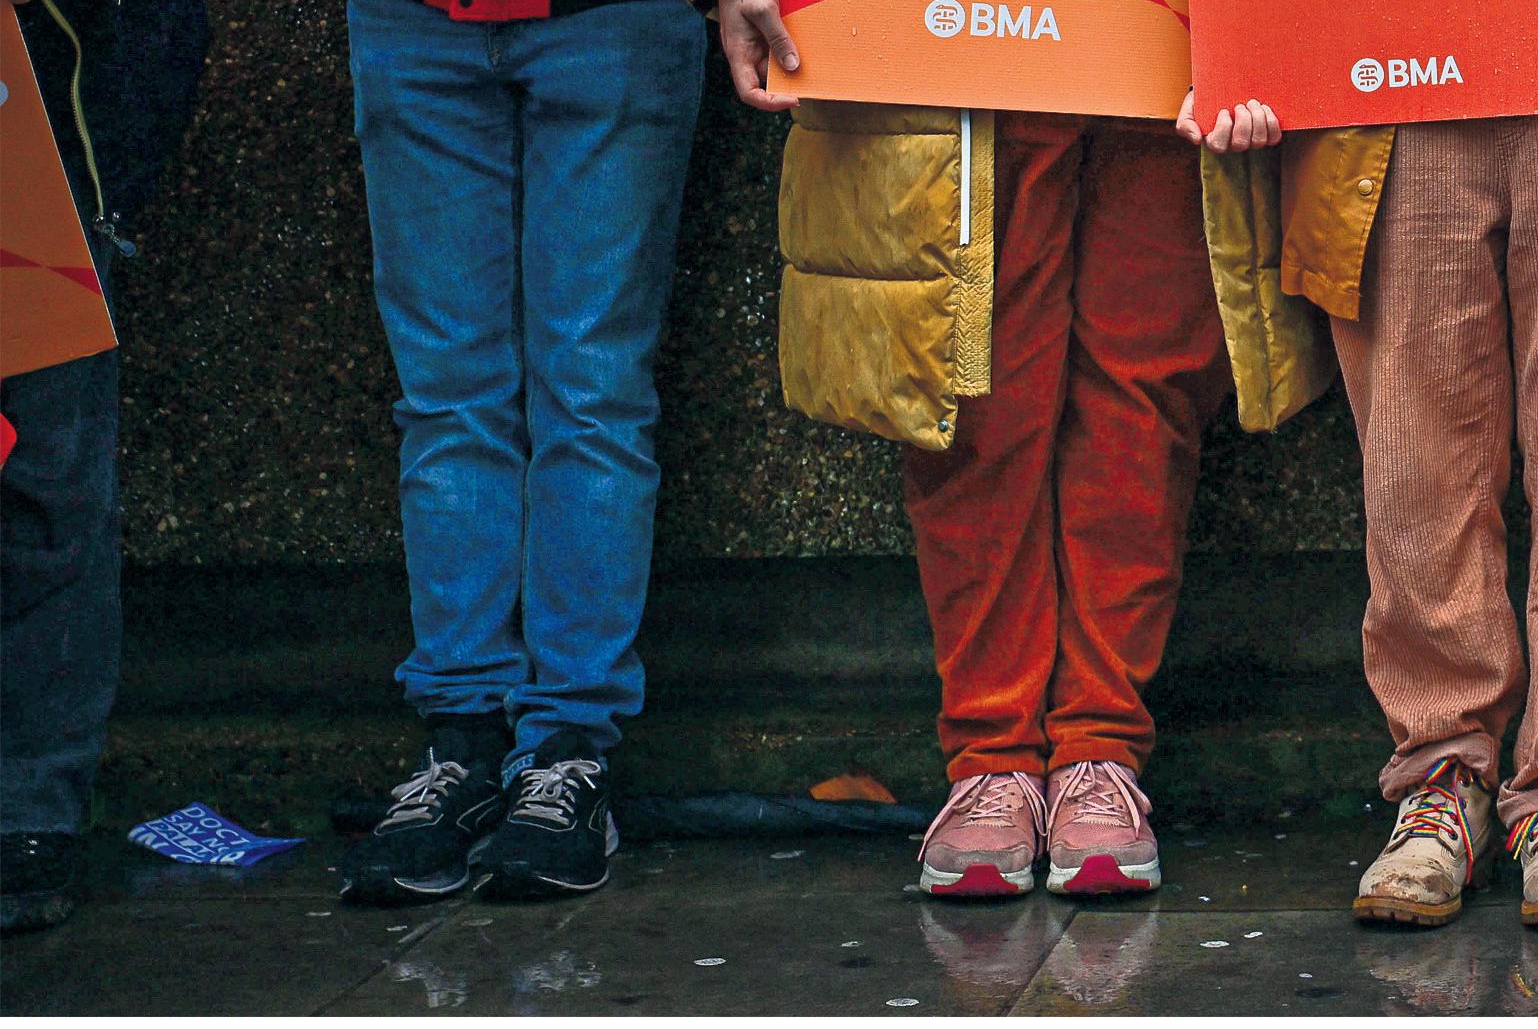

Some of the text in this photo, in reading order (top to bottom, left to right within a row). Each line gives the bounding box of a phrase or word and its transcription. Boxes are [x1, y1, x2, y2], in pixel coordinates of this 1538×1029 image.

[969, 4, 1062, 42] BMA
[1387, 55, 1464, 89] BMA
[180, 807, 251, 845] DOCT
